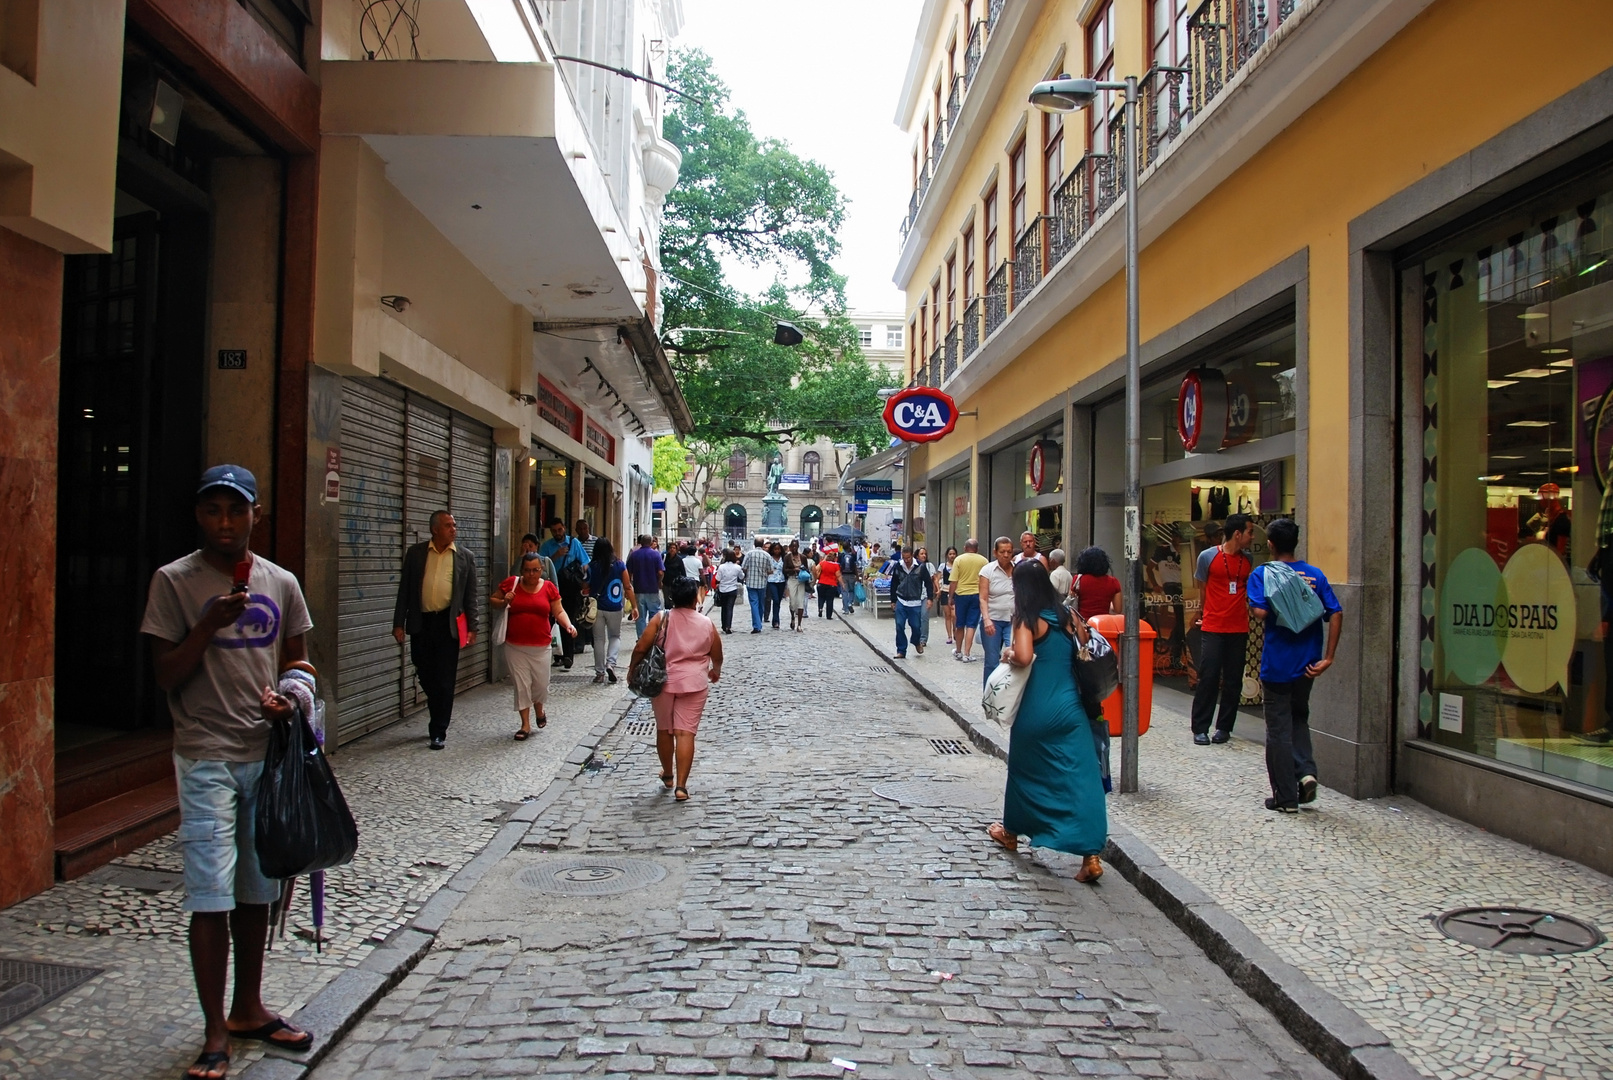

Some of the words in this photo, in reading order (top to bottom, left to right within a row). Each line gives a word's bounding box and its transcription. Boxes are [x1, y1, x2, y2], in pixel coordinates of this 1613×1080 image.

[223, 352, 242, 367] 183
[893, 402, 946, 428] C&A
[856, 484, 891, 493] Requinte
[1146, 594, 1163, 603] DIA
[1453, 604, 1480, 627] DIA
[1483, 604, 1518, 628] DOS
[1520, 604, 1558, 630] PAIS
